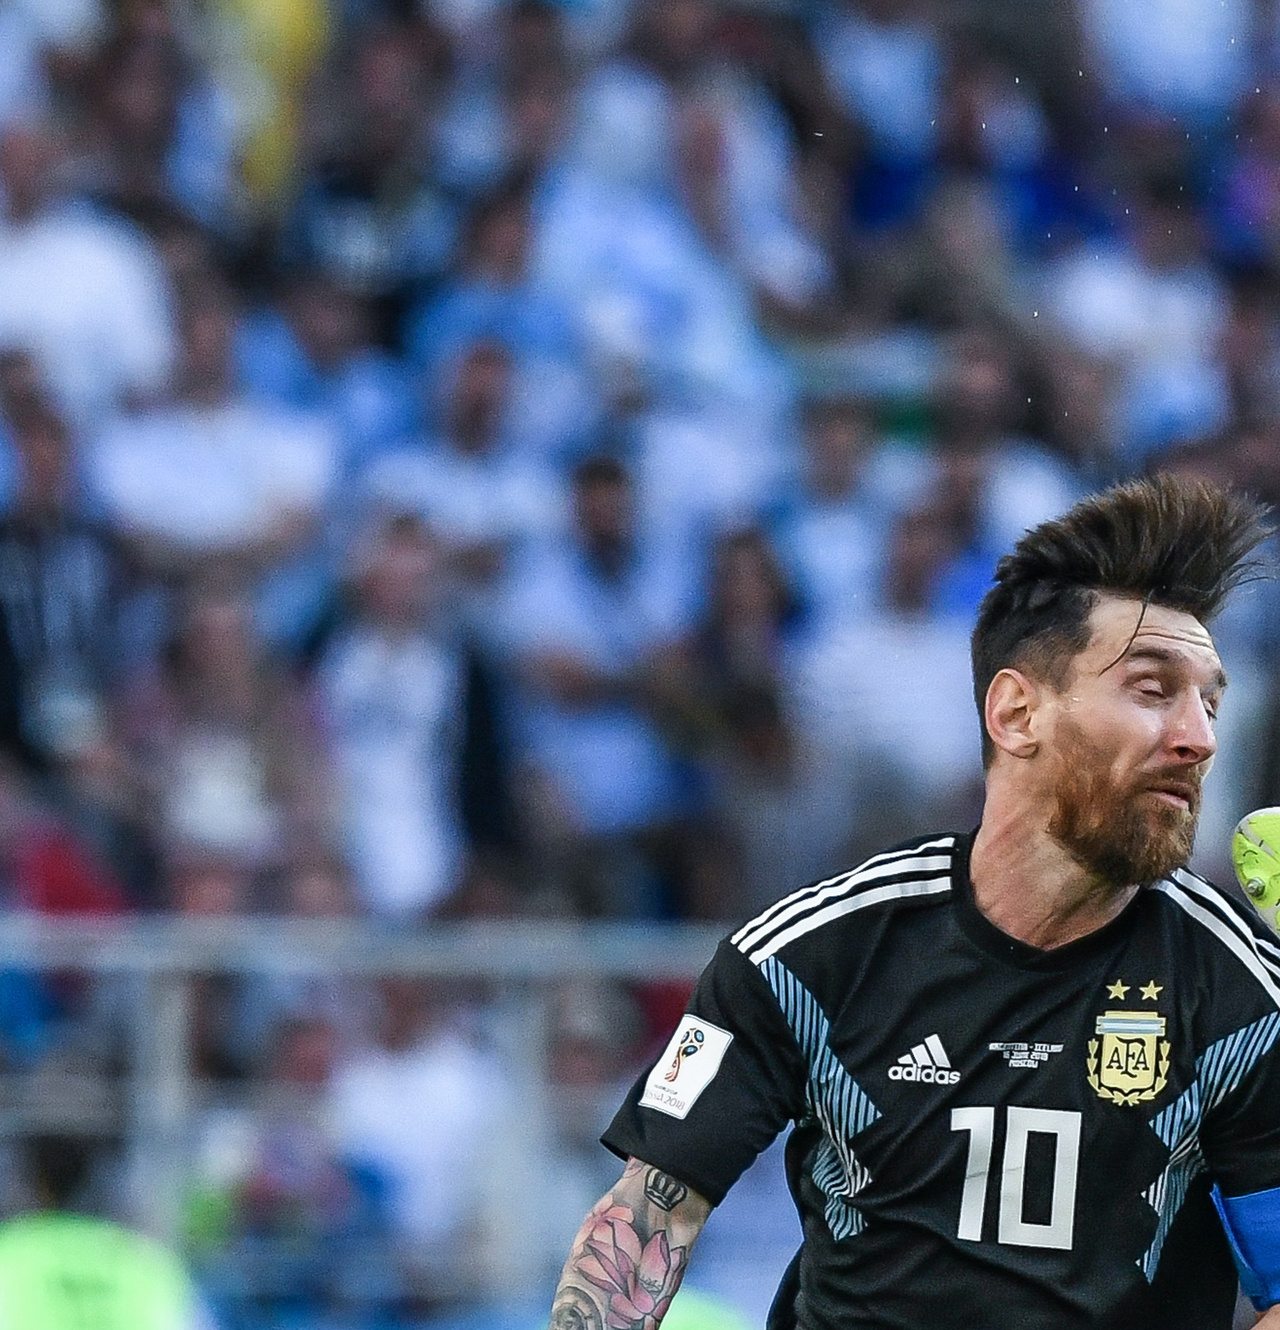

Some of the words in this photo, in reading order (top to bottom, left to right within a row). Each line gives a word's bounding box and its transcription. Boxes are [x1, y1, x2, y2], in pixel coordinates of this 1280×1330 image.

[1106, 1037, 1150, 1078] AFA
[888, 1064, 961, 1085] adidas
[663, 1095, 686, 1111] 2018
[951, 1105, 1082, 1250] 10
